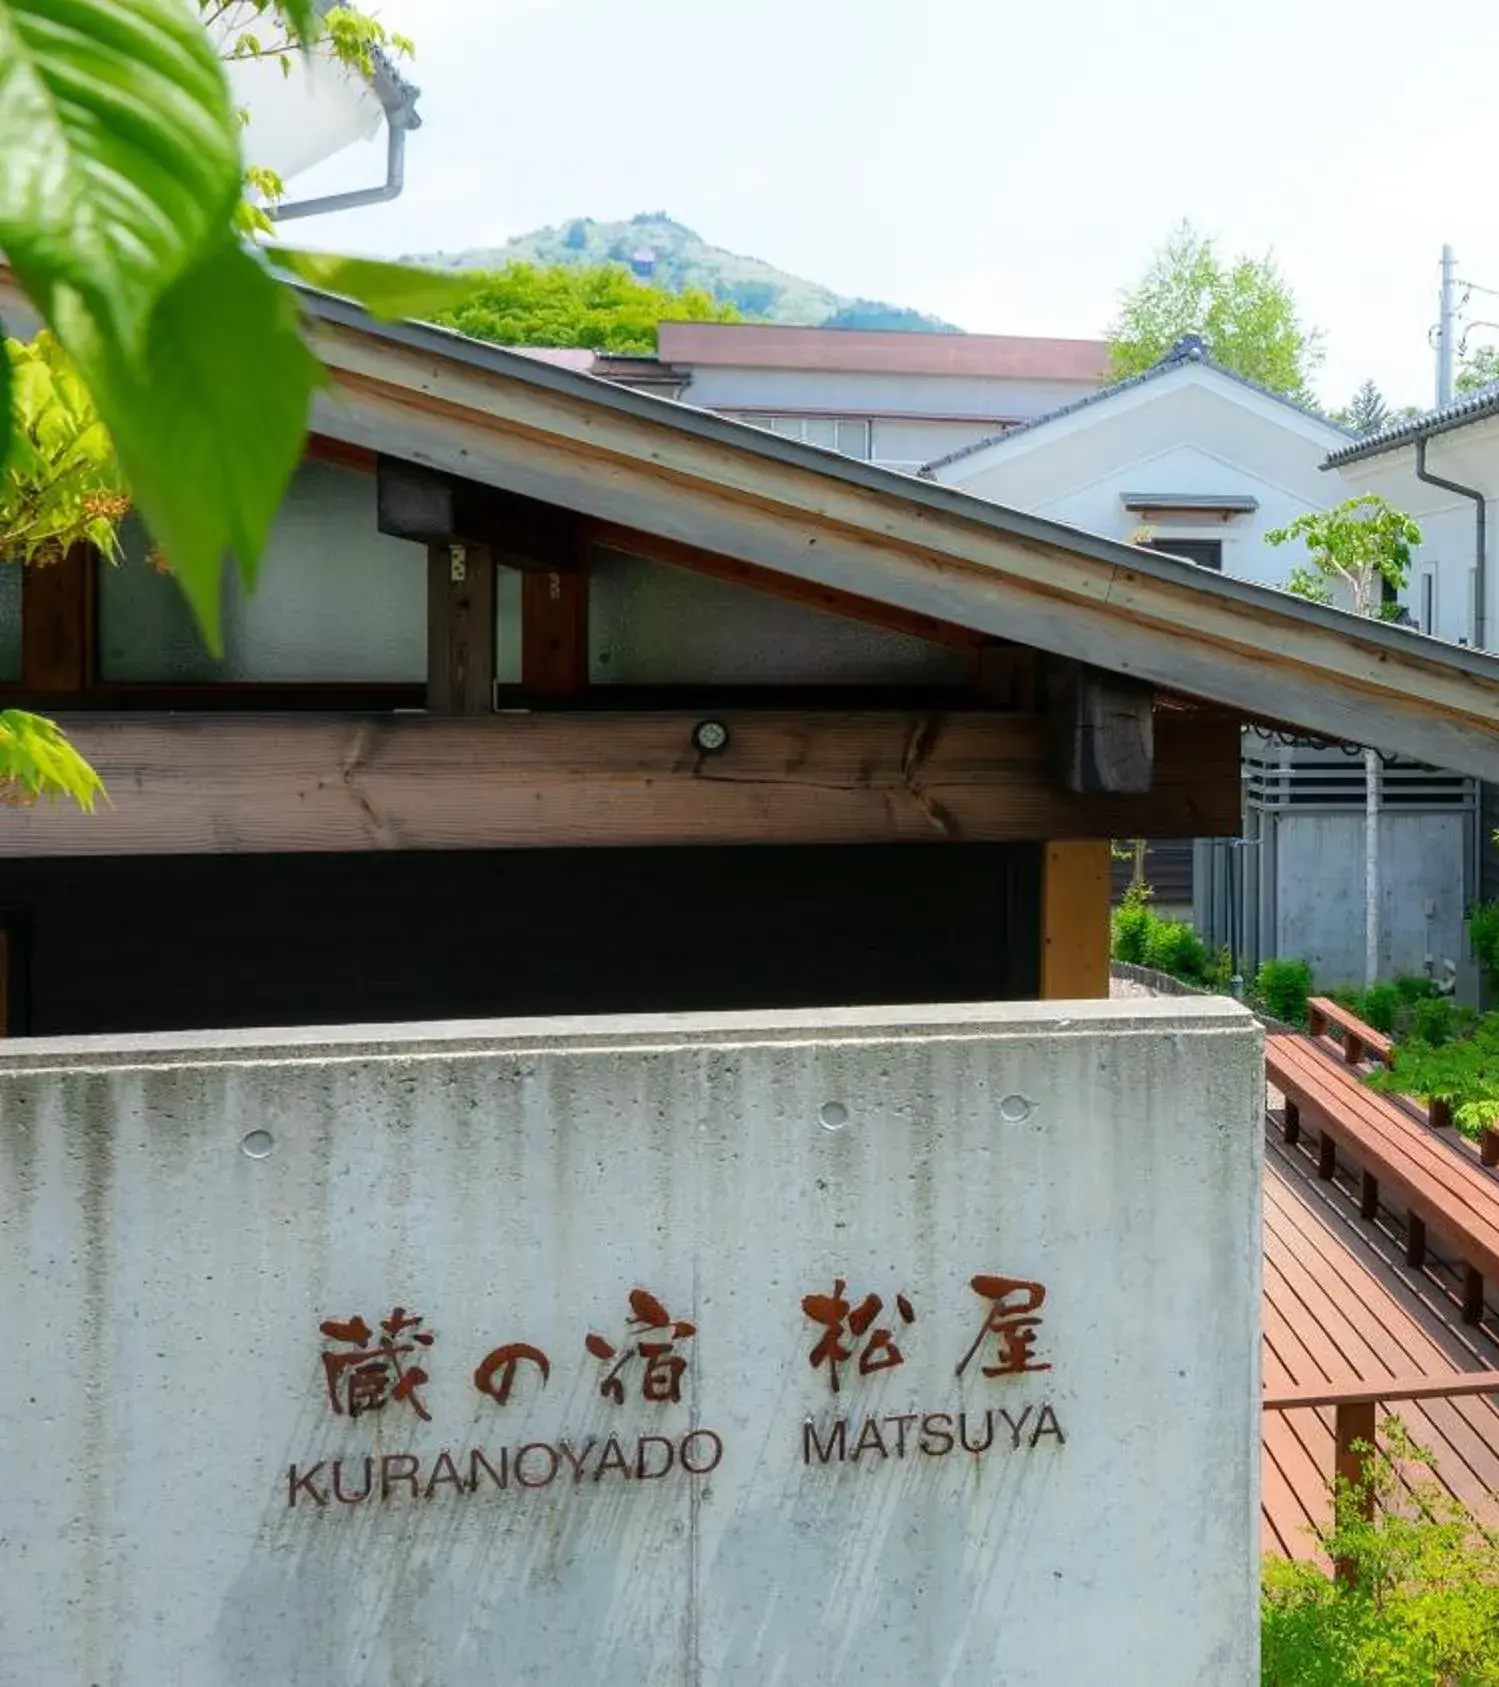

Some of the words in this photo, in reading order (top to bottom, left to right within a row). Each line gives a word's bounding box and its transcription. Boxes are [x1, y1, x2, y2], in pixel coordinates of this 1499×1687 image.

[319, 1288, 697, 1421] 蔵の宿
[802, 1275, 1052, 1393] 松屋
[287, 1429, 723, 1508] KURANOYADO
[804, 1403, 1066, 1465] MATSUYA
